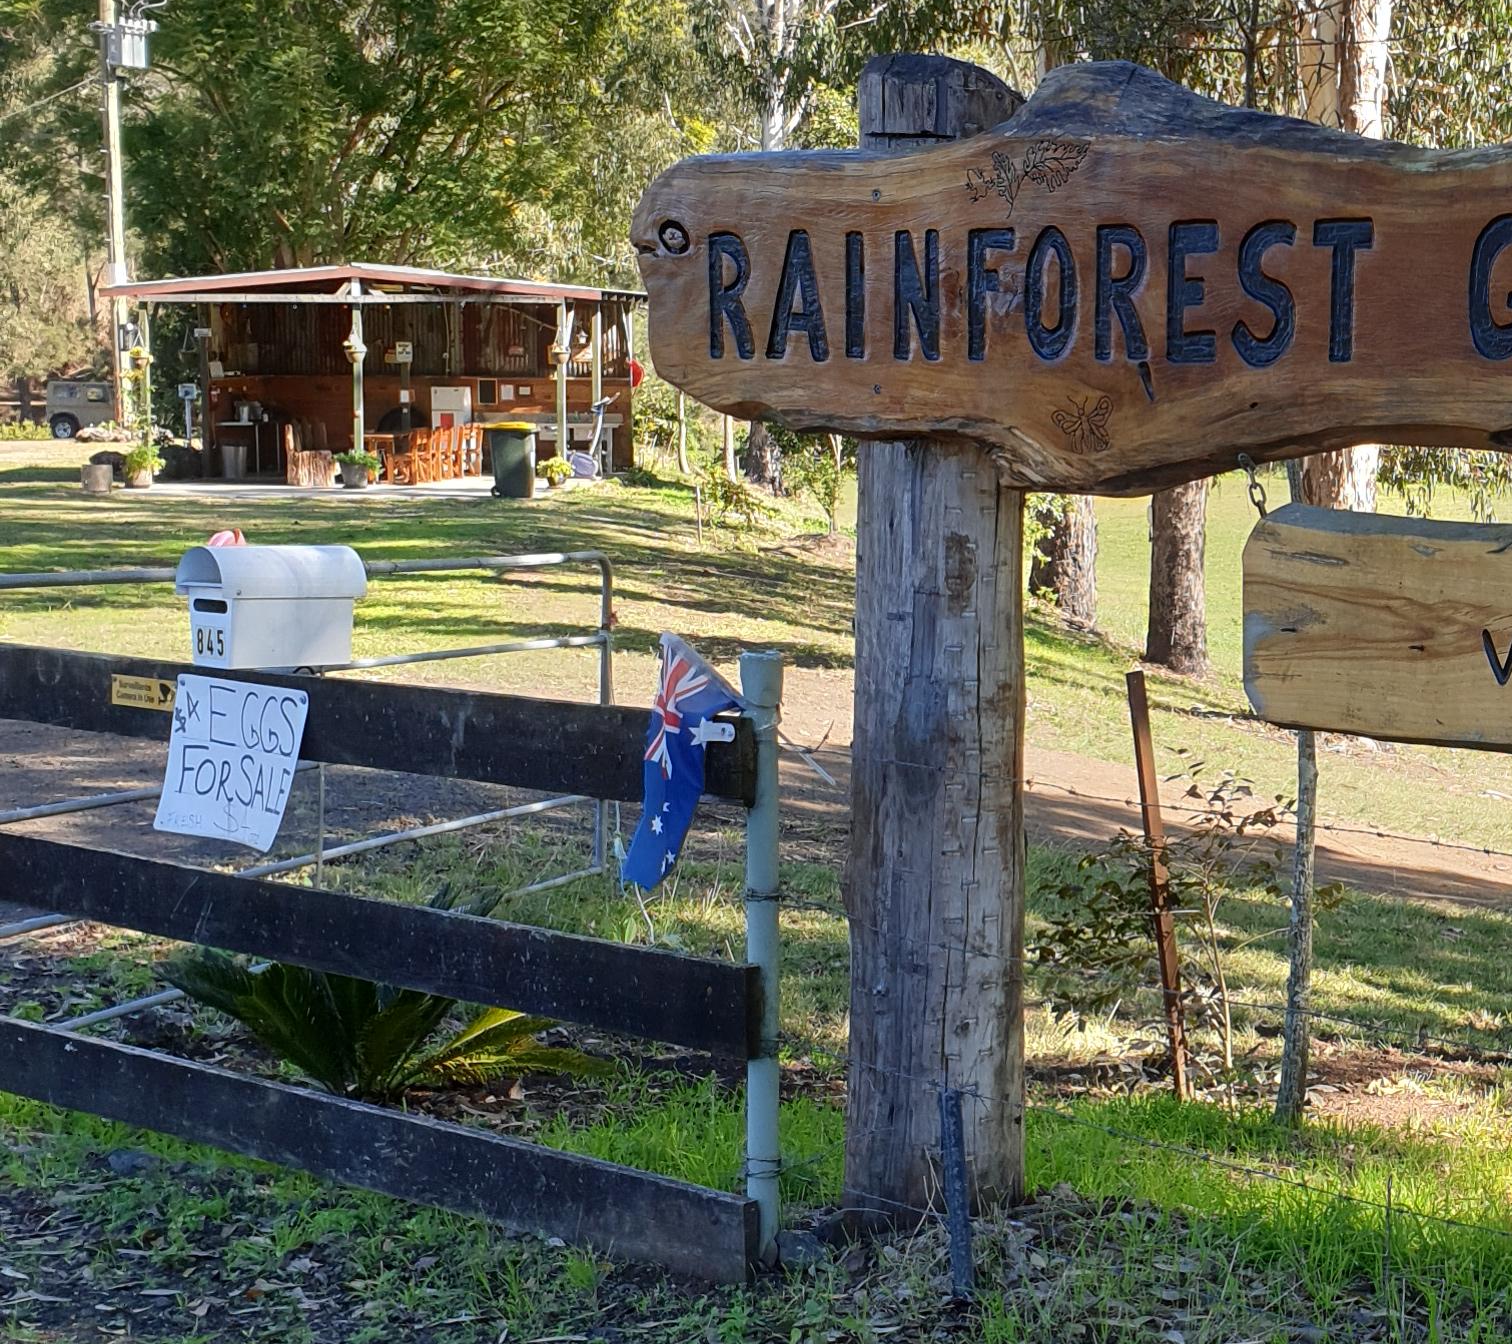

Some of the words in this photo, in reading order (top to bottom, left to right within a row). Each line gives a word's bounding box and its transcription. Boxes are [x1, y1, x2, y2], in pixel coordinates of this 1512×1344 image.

[707, 216, 1375, 369] RAINFOREST
[197, 627, 225, 657] 845
[209, 684, 298, 757] EGGS
[178, 744, 234, 802] FOR
[234, 754, 291, 815] SALE
